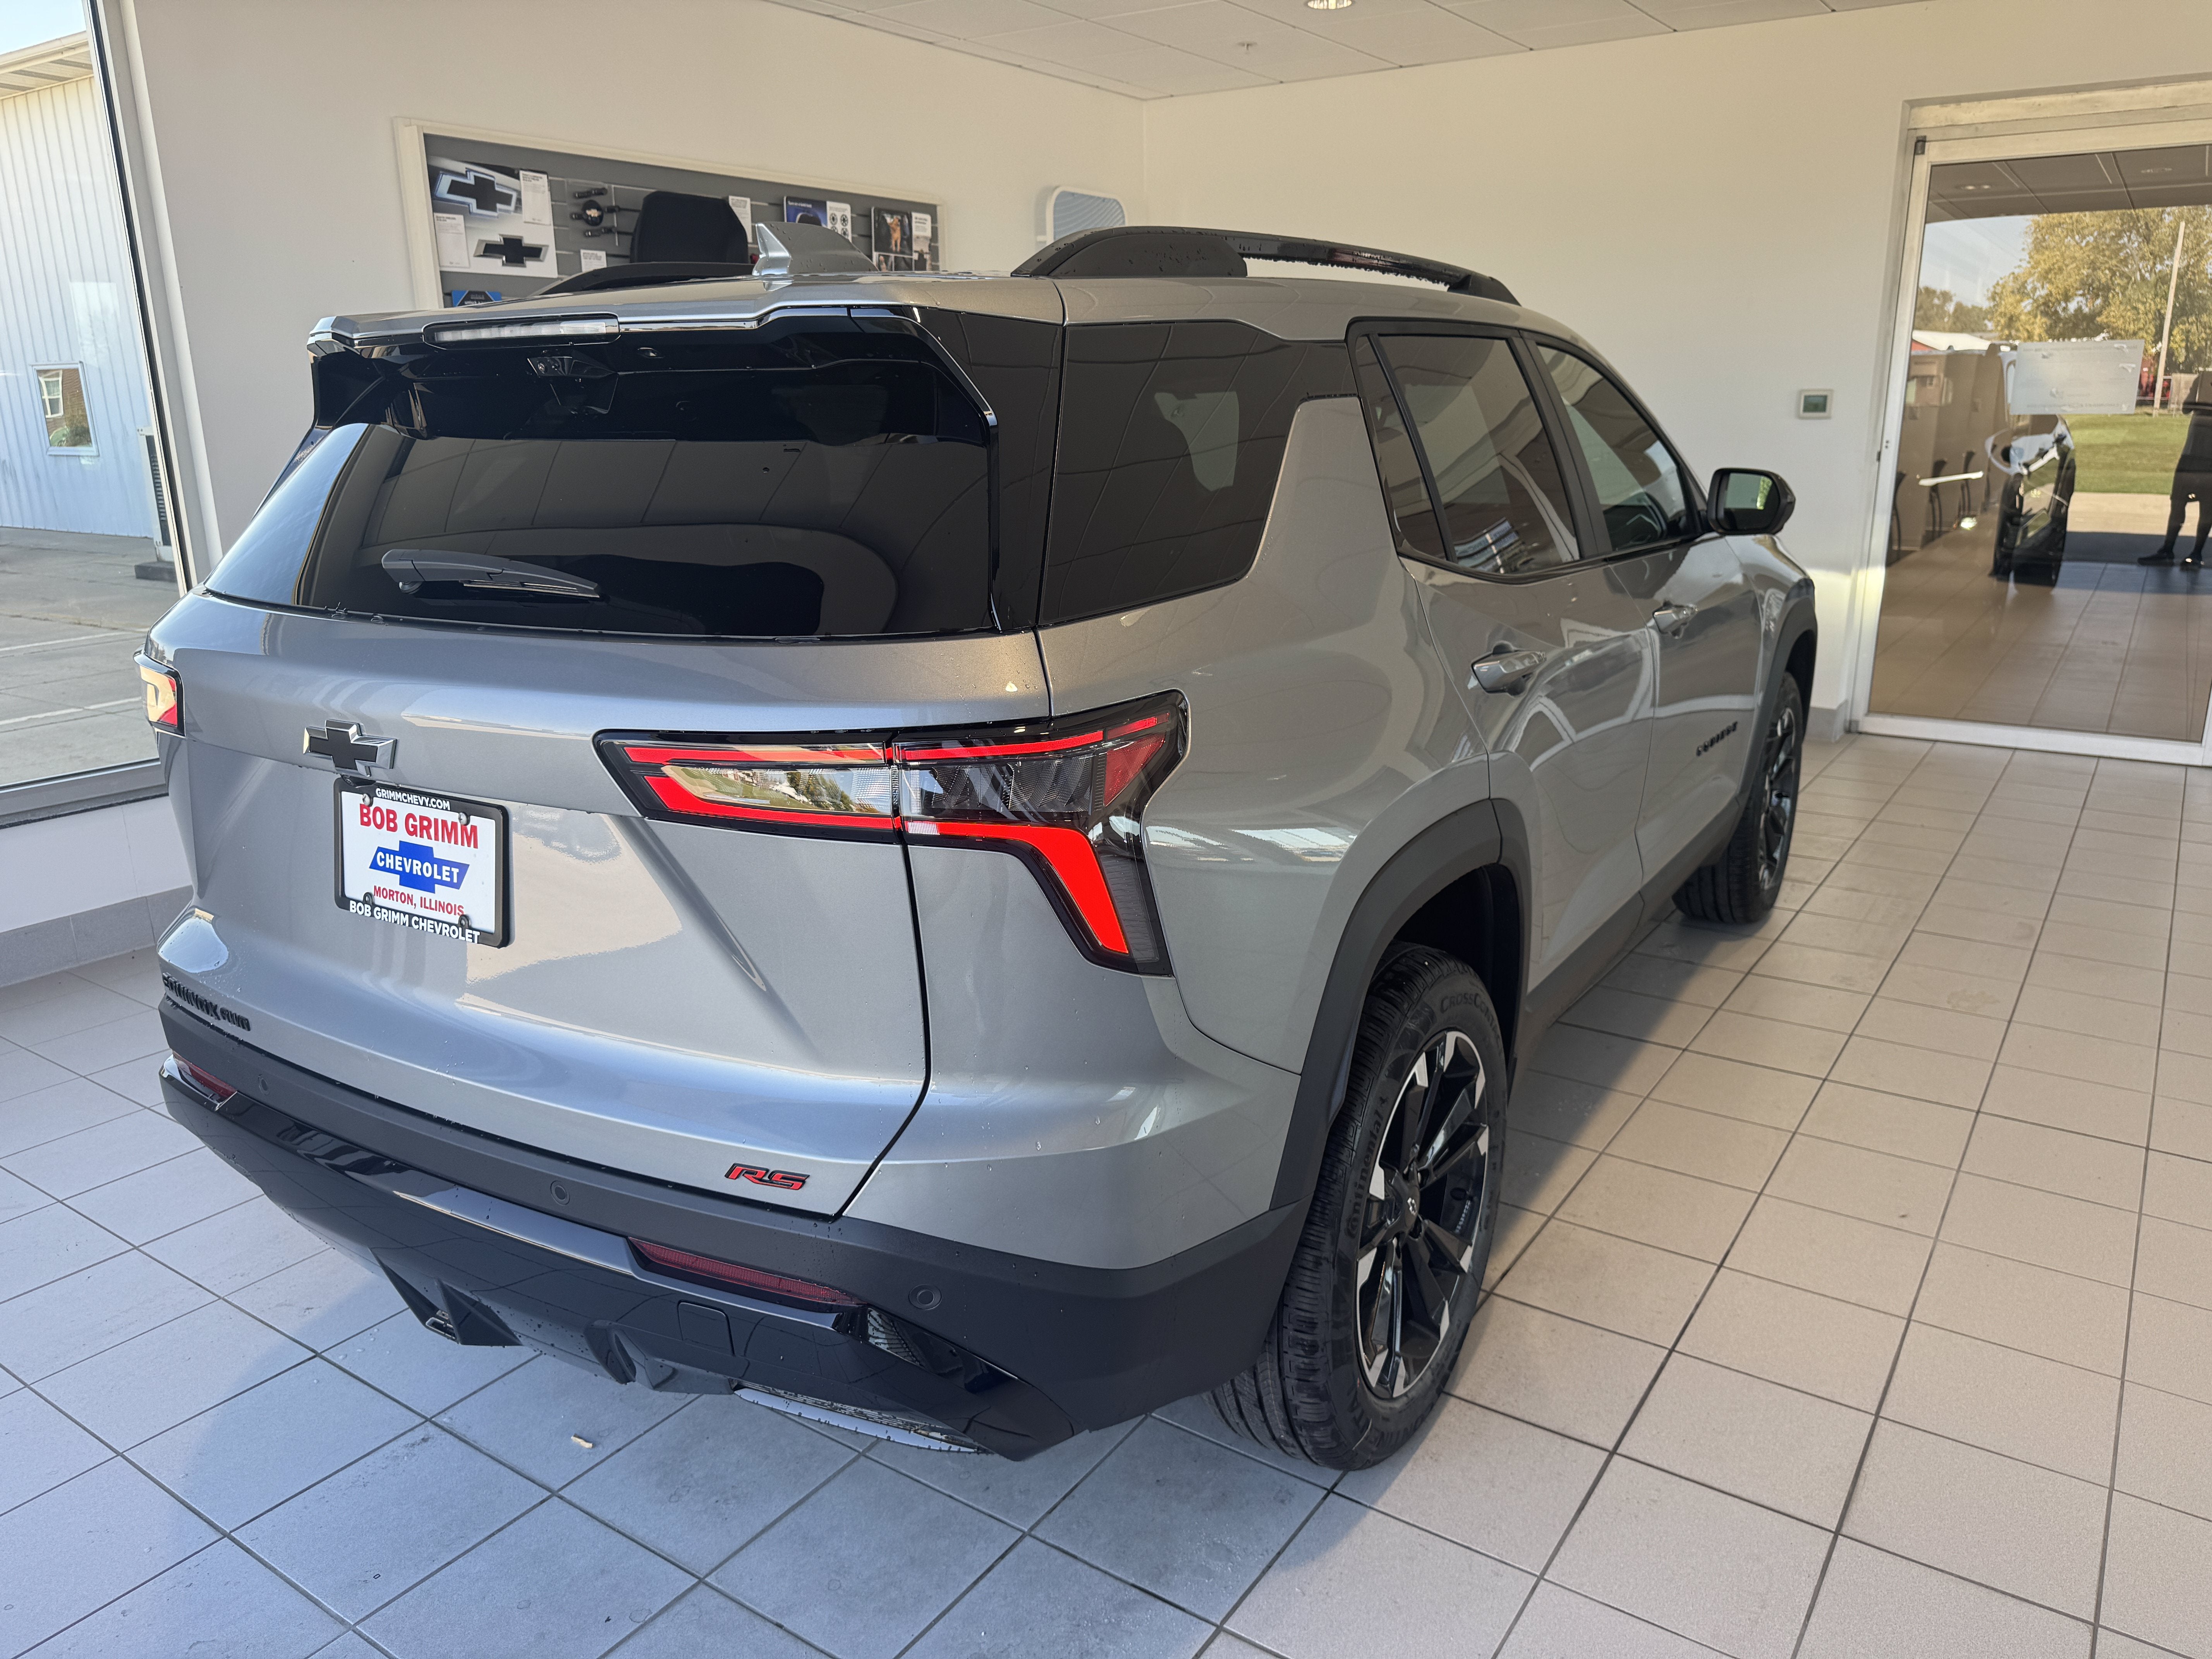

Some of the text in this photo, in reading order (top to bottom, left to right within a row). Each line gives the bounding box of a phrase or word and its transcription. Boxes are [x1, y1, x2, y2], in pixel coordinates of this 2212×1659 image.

[376, 788, 450, 811] GRIMMCHEVY.COM
[360, 804, 478, 849] BOB GRIMM
[376, 852, 459, 883] CHEVROLET
[373, 885, 464, 916] MORTON, ILLINOIS
[350, 900, 480, 944] BOB GRIMM CHEVROLET
[724, 1163, 810, 1190] RS
[1344, 1109, 1384, 1239] Continental
